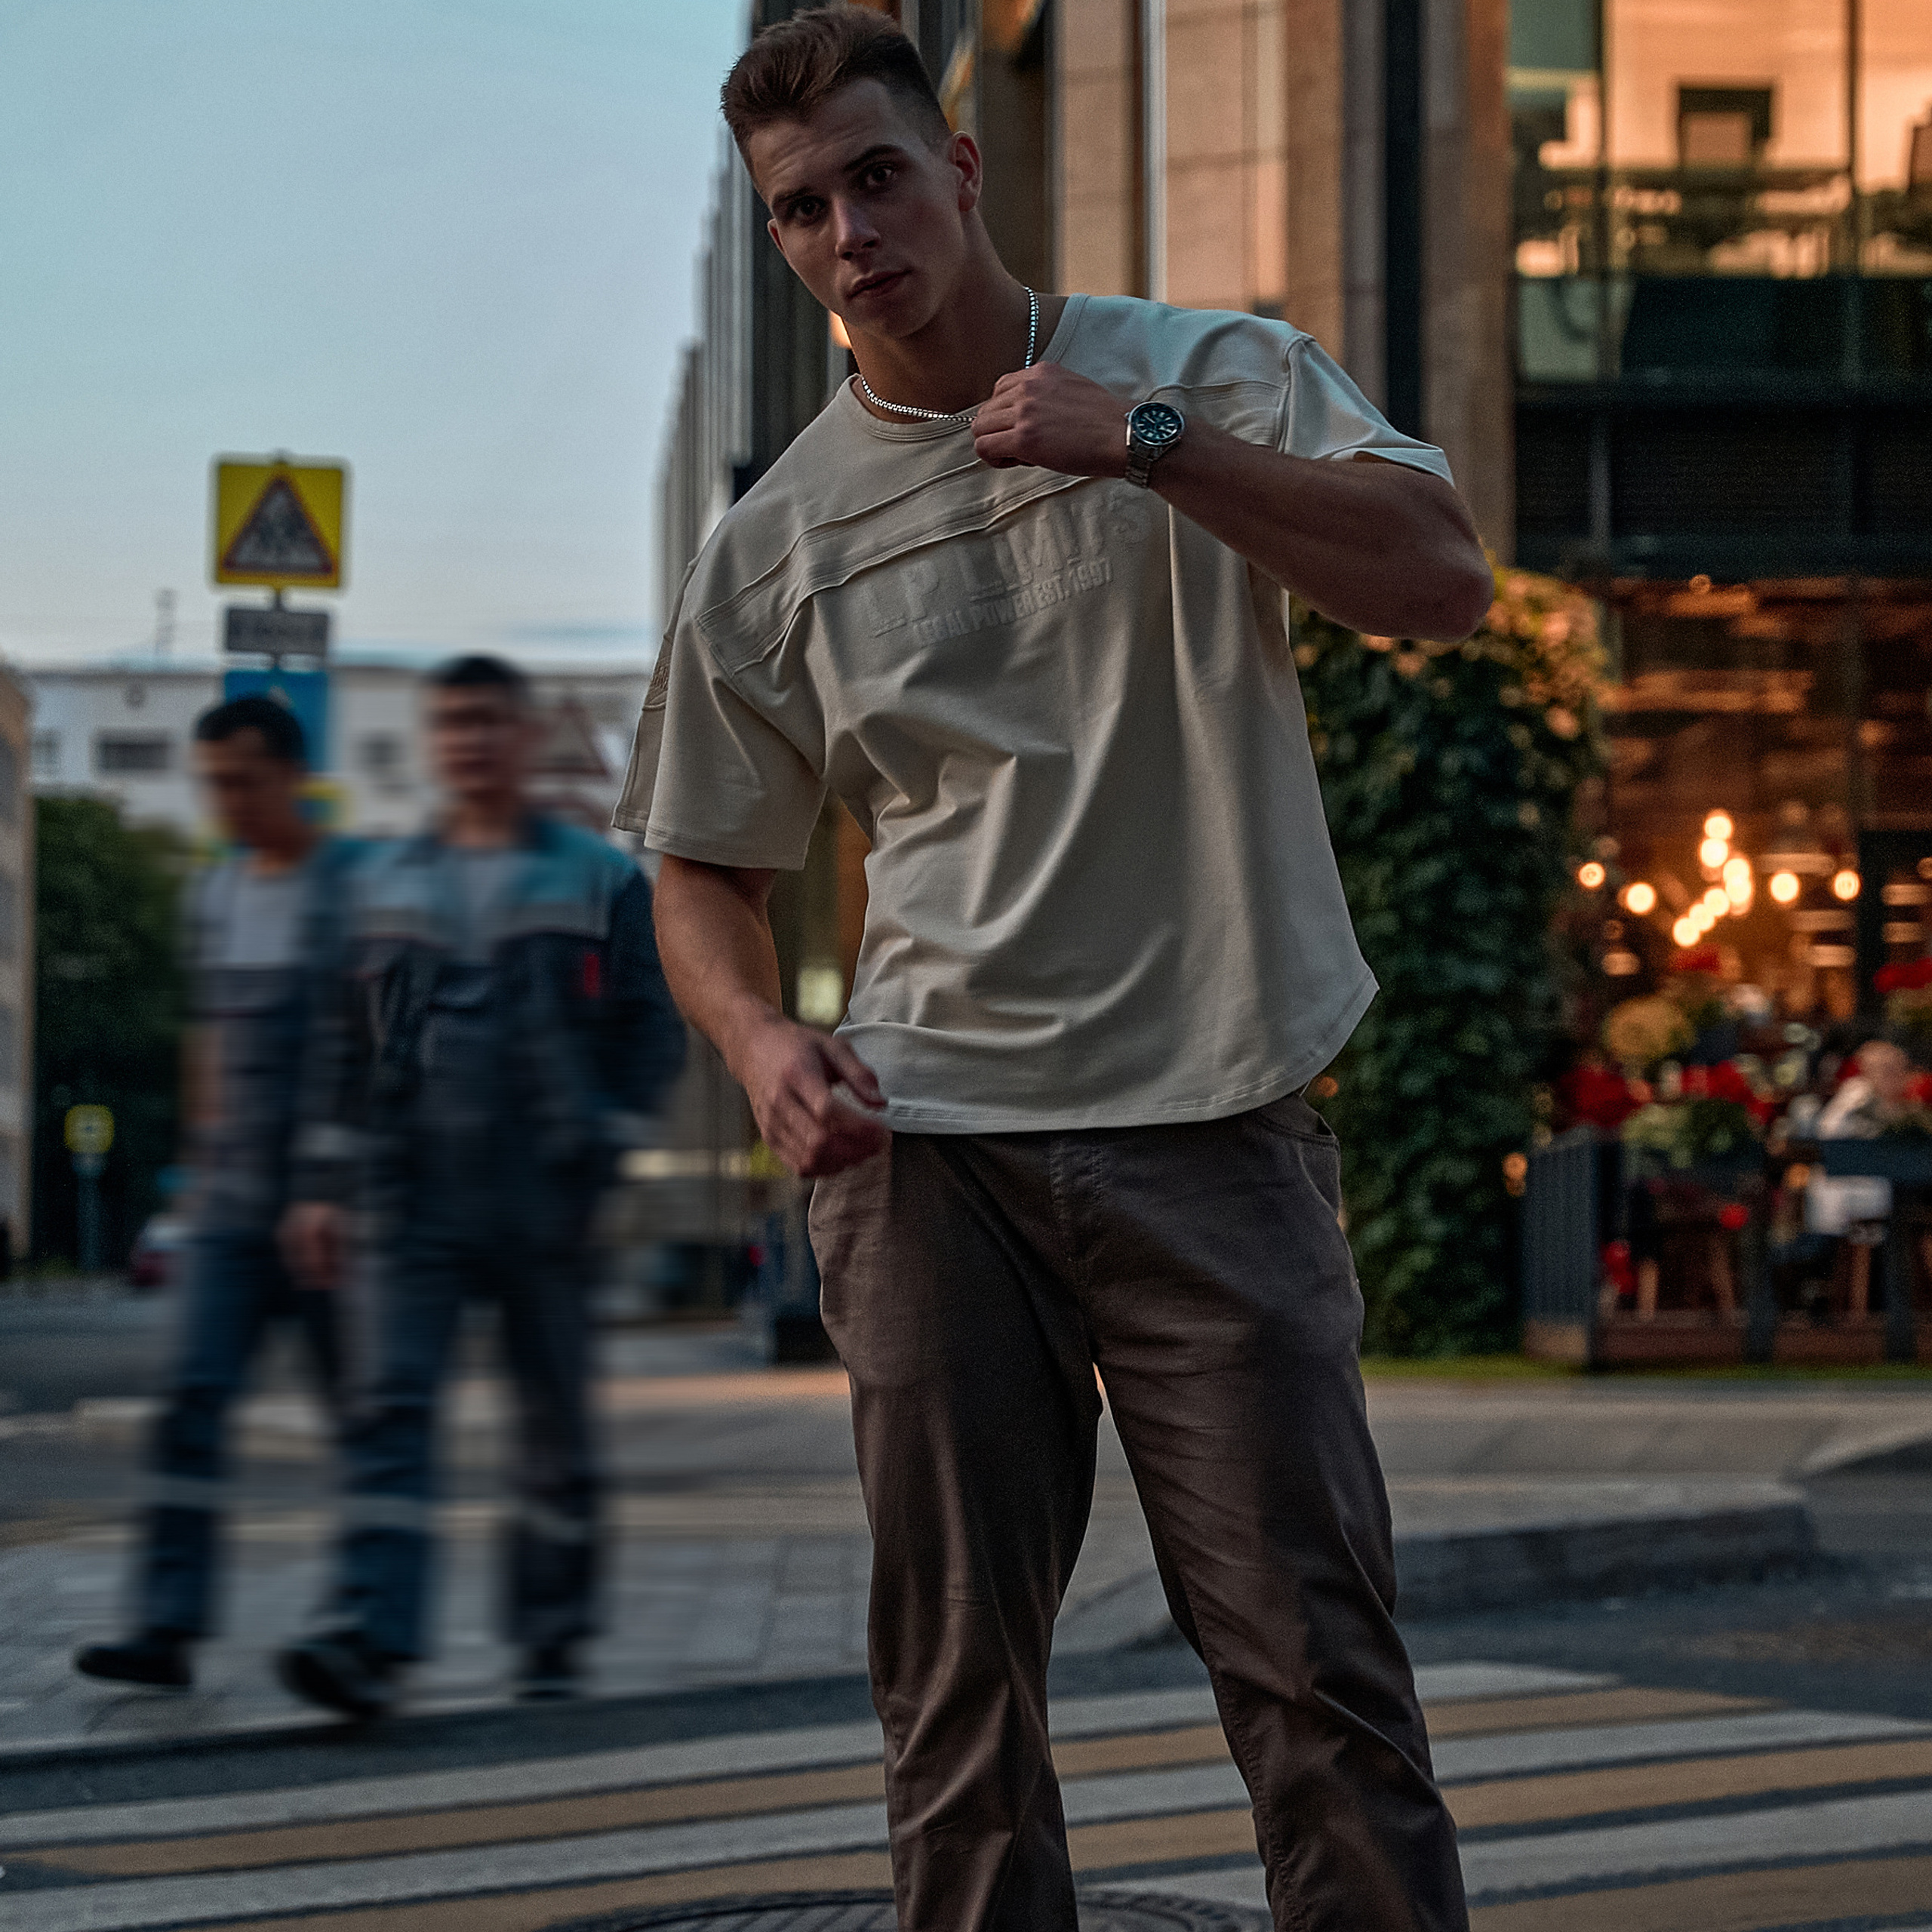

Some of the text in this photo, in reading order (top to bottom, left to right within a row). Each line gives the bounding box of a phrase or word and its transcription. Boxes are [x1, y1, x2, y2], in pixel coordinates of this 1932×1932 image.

[911, 557, 1113, 644] LEGAL POWER EST. 1997
